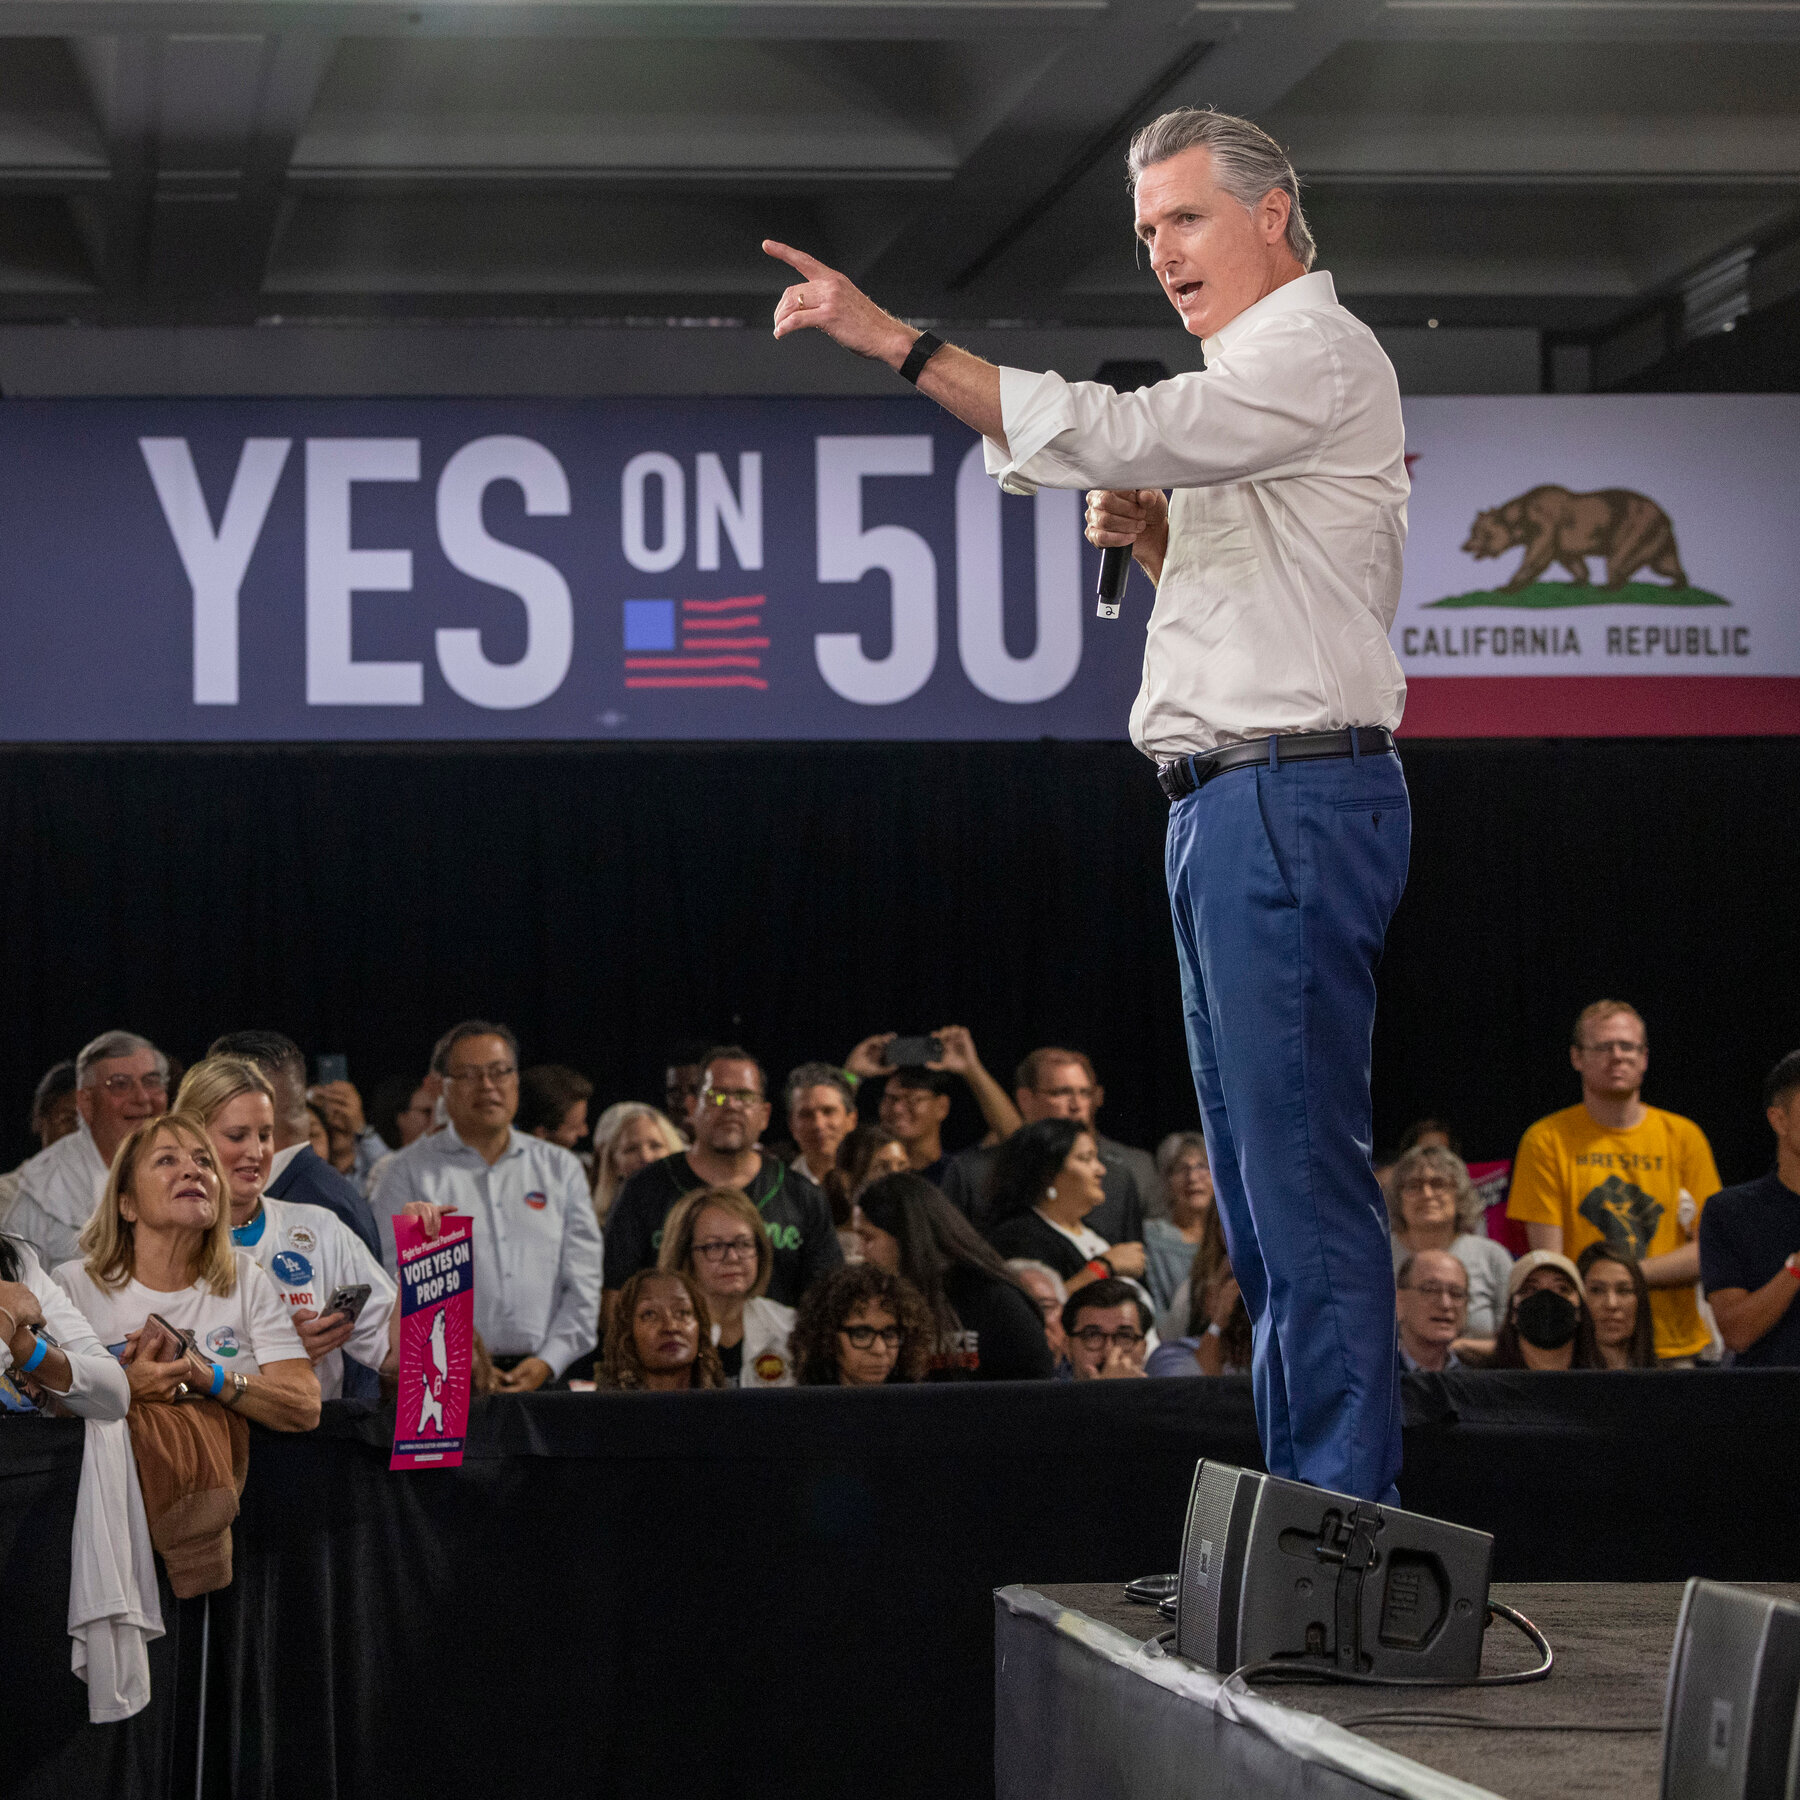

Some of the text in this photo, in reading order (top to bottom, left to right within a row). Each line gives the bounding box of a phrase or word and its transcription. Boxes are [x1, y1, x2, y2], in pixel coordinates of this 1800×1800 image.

[139, 434, 1084, 710] YES ON 50
[1403, 626, 1751, 657] CALIFORNIA REPUBLIC
[404, 1242, 470, 1286] VOTE YES ON
[289, 1292, 314, 1305] HOT
[416, 1270, 460, 1305] PROP 50
